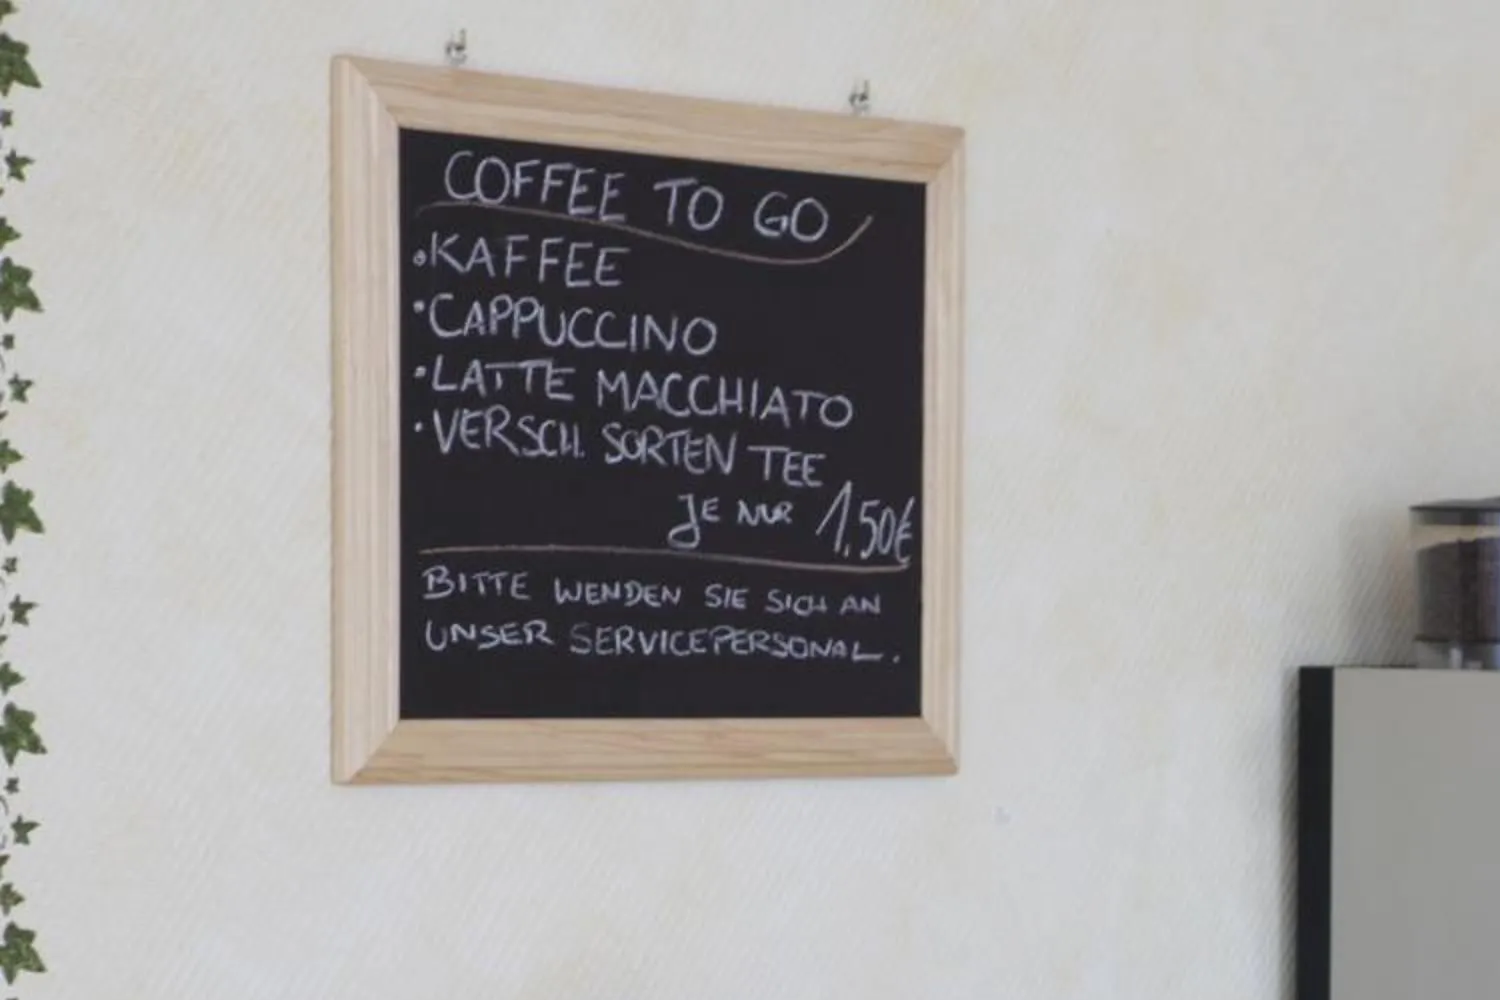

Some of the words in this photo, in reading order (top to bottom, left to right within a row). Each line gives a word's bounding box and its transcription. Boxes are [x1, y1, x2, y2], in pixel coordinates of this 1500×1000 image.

[444, 150, 625, 223] COFFEE
[653, 178, 724, 231] TO
[753, 191, 829, 242] GO
[431, 231, 628, 288] KAFFEE
[429, 292, 718, 356] CAPPUCCINO
[431, 354, 575, 401] LATTE
[597, 369, 853, 428] MACCHIATO
[601, 422, 737, 475] SORTEN
[747, 445, 826, 487] TEE
[667, 493, 720, 549] JE
[737, 499, 793, 526] NUR
[422, 565, 529, 600] BITTE
[554, 578, 682, 608] WENDEN
[705, 583, 748, 609] SIE
[765, 589, 828, 617] SICH
[840, 595, 881, 614] AN
[425, 619, 554, 651] UNSER
